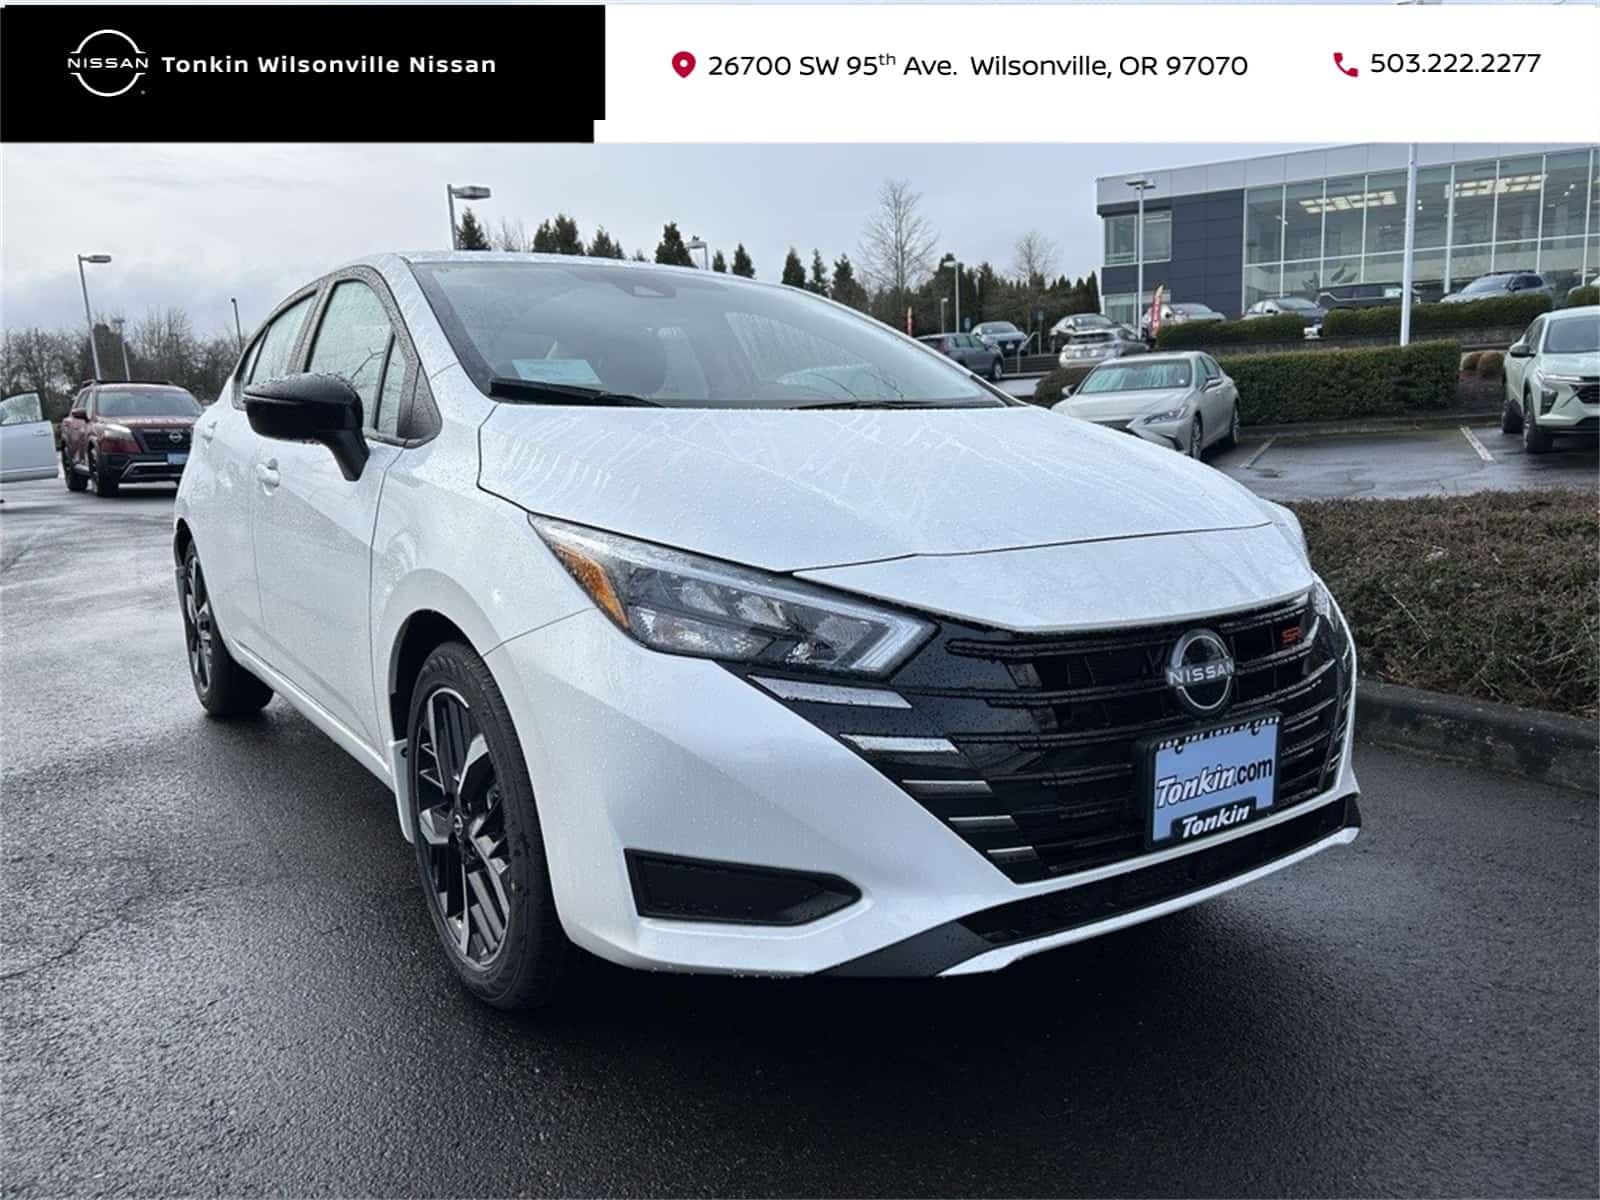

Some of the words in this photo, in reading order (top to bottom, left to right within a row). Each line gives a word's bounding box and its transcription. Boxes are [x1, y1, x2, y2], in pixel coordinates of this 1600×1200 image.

[1168, 659, 1235, 685] NISSAN
[1155, 758, 1273, 809] Tonkin.com
[1182, 804, 1250, 839] Tonkin
